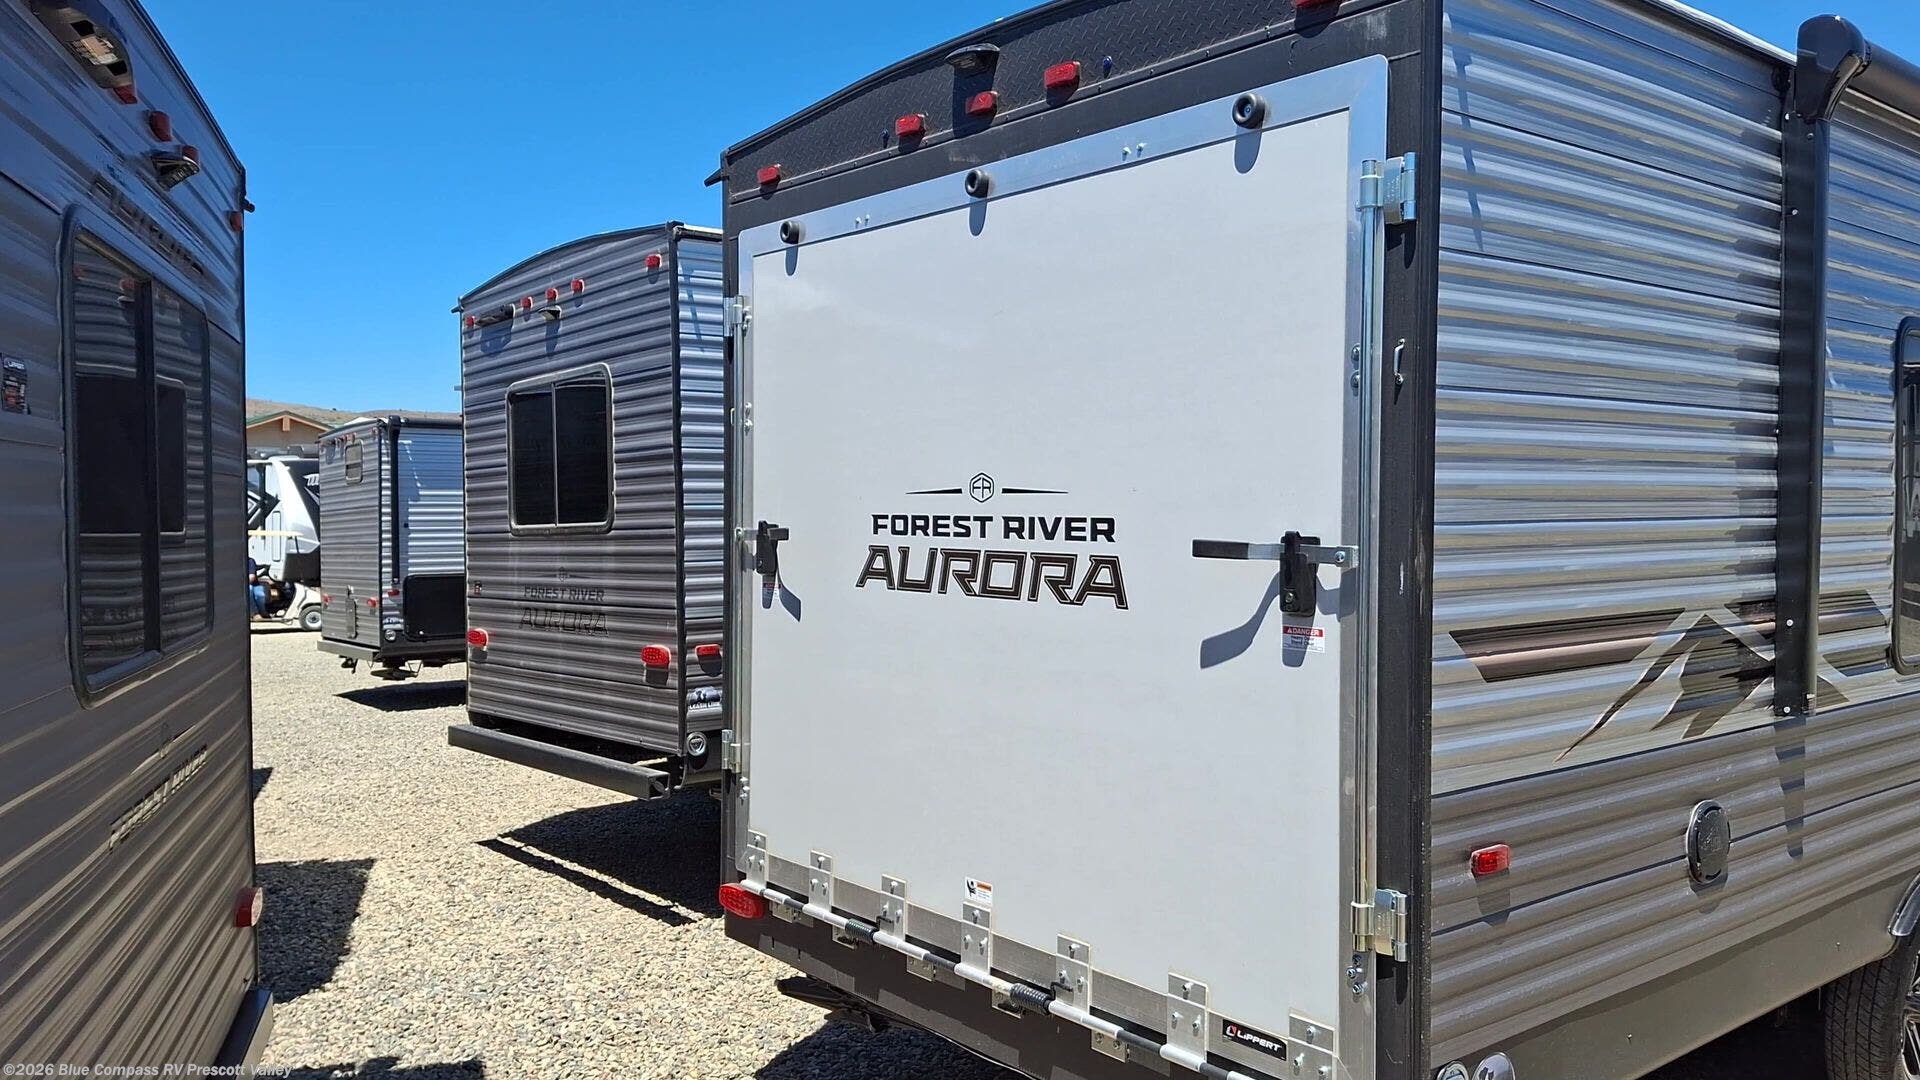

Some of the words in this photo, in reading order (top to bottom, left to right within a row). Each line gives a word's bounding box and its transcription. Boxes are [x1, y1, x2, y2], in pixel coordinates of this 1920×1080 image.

[872, 514, 993, 539] FOREST
[1002, 516, 1116, 543] RIVER
[855, 545, 1129, 610] AURORA
[523, 585, 568, 601] FOREST
[568, 587, 605, 602] RIVER
[519, 608, 610, 636] AURORA
[1292, 627, 1320, 636] DANGER
